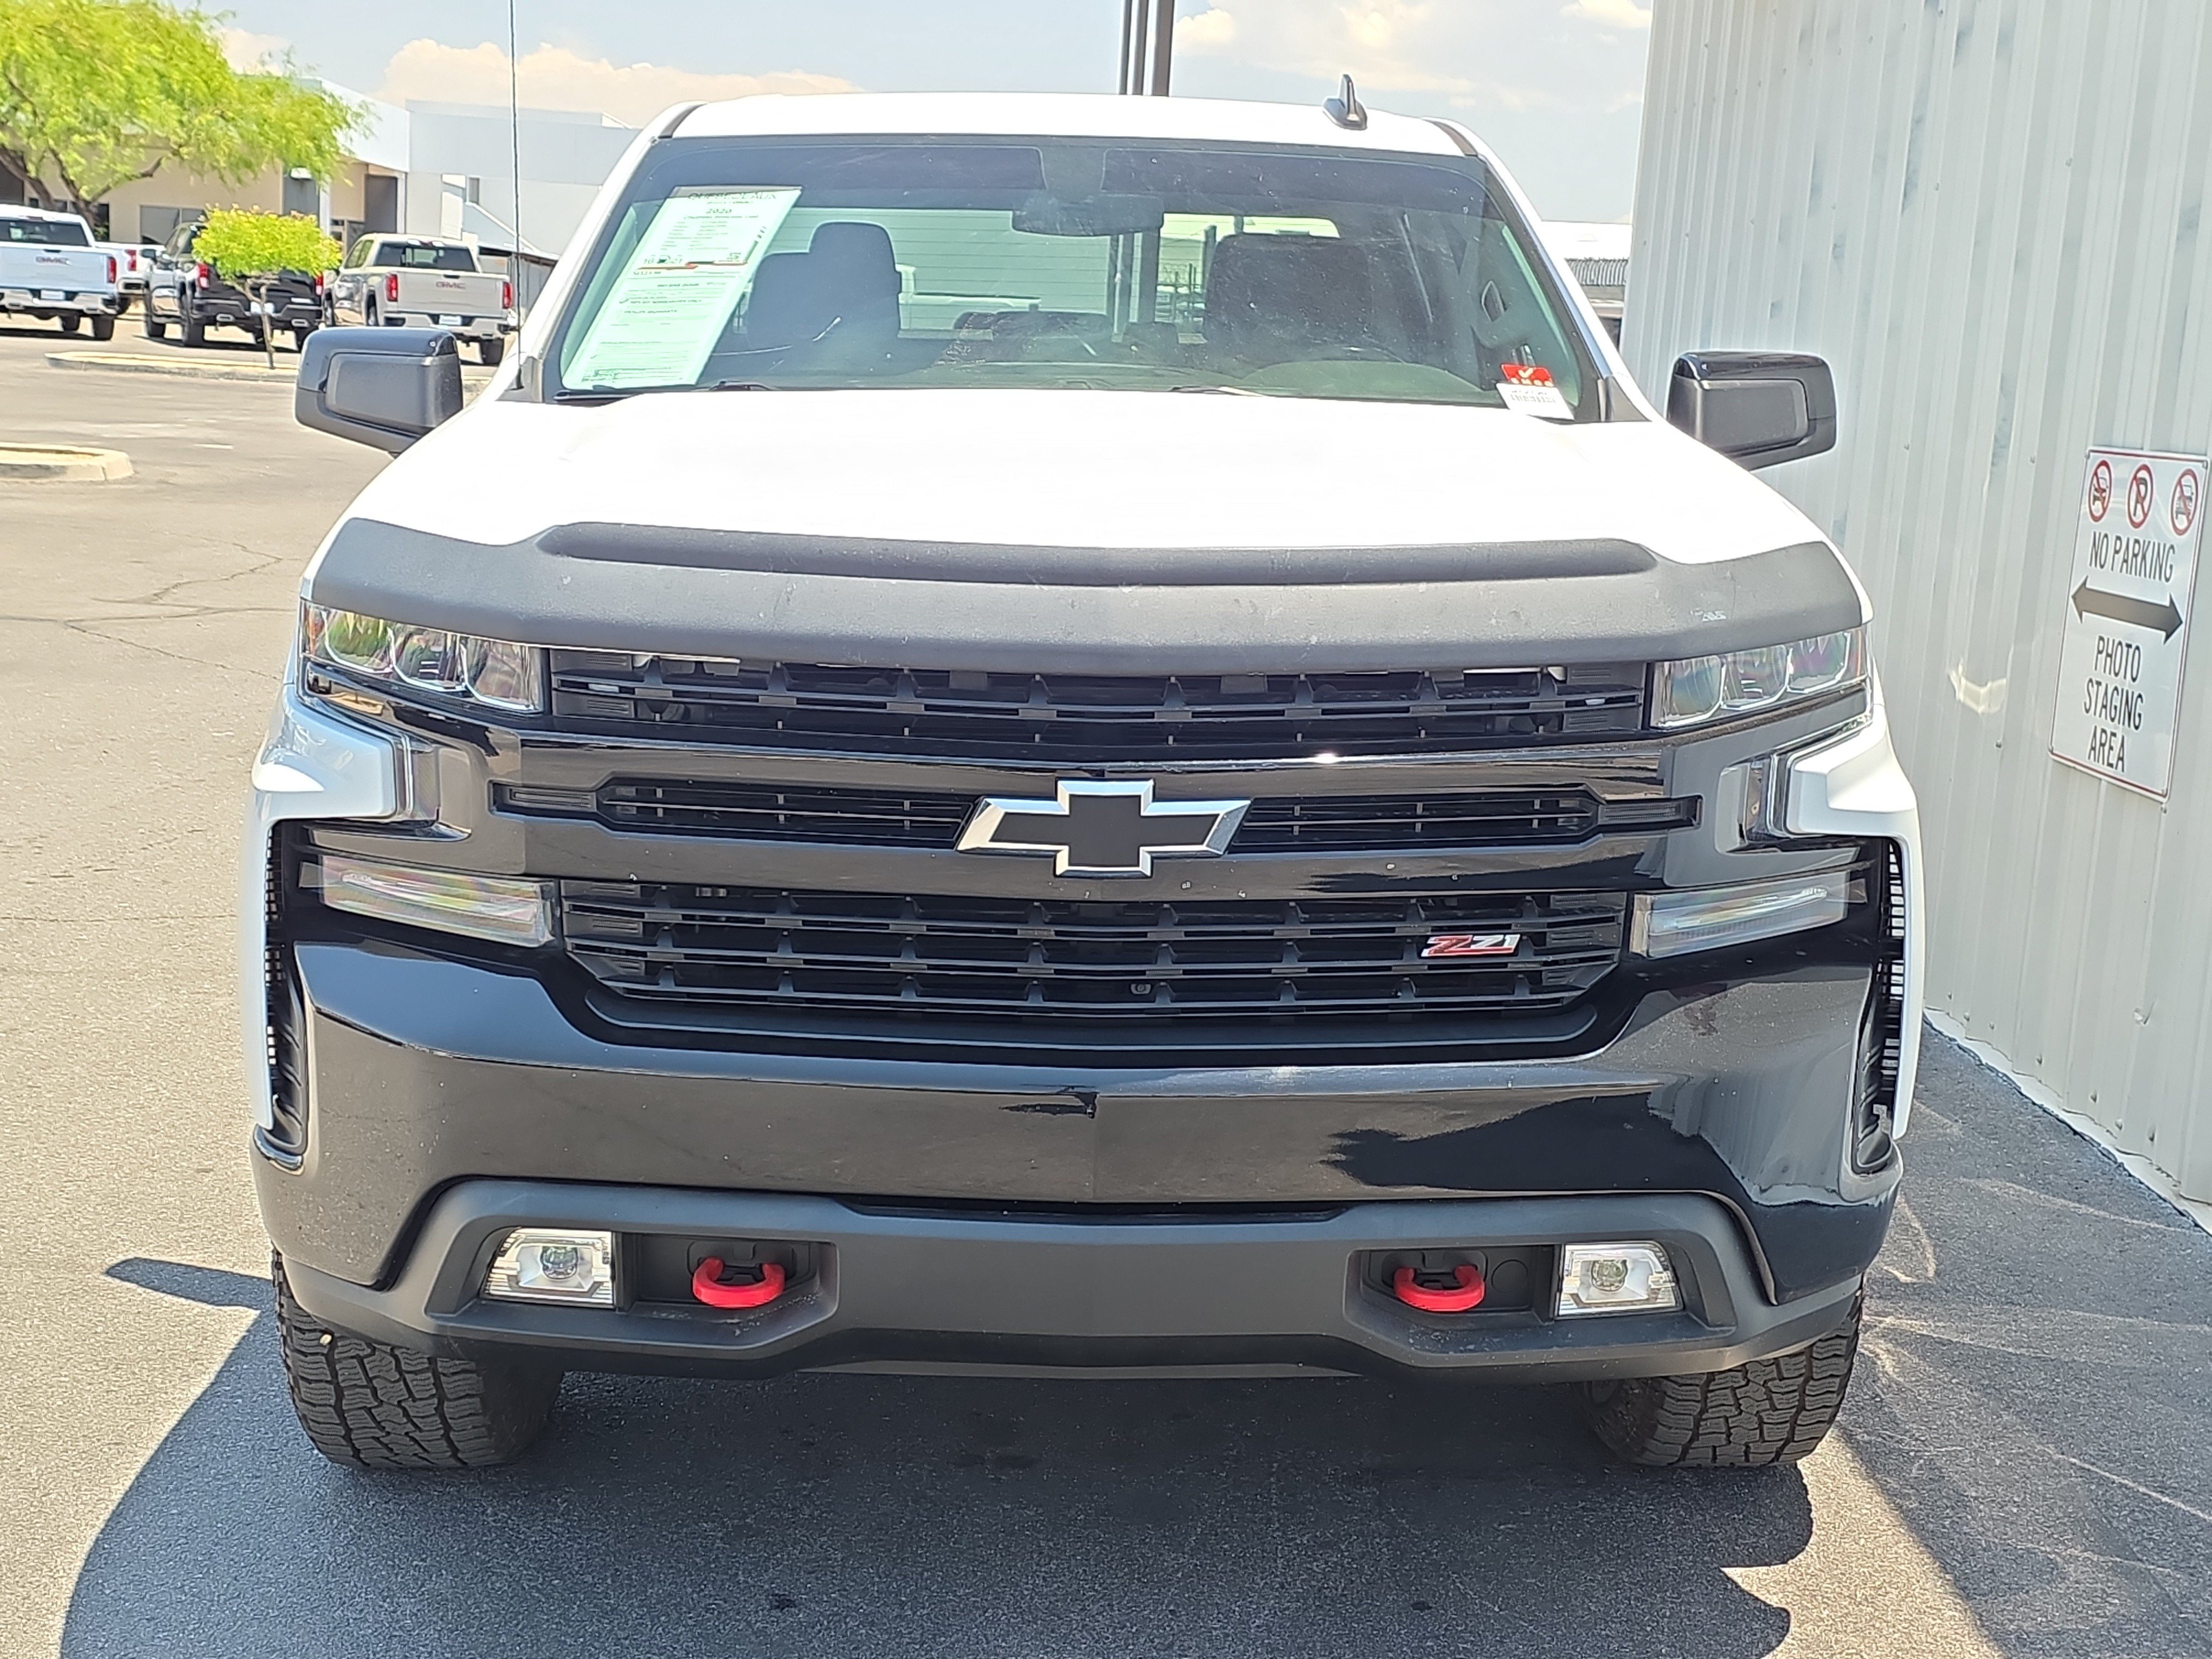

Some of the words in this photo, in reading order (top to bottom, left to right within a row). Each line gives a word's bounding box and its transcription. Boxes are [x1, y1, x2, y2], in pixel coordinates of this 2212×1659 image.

[436, 281, 466, 290] GMC
[2089, 531, 2109, 570] NO
[2111, 535, 2175, 582] PARKING
[2094, 635, 2142, 682] PHOTO
[2084, 678, 2143, 730] STAGING
[2088, 725, 2125, 772] AREA
[1420, 934, 1521, 957] Z71
